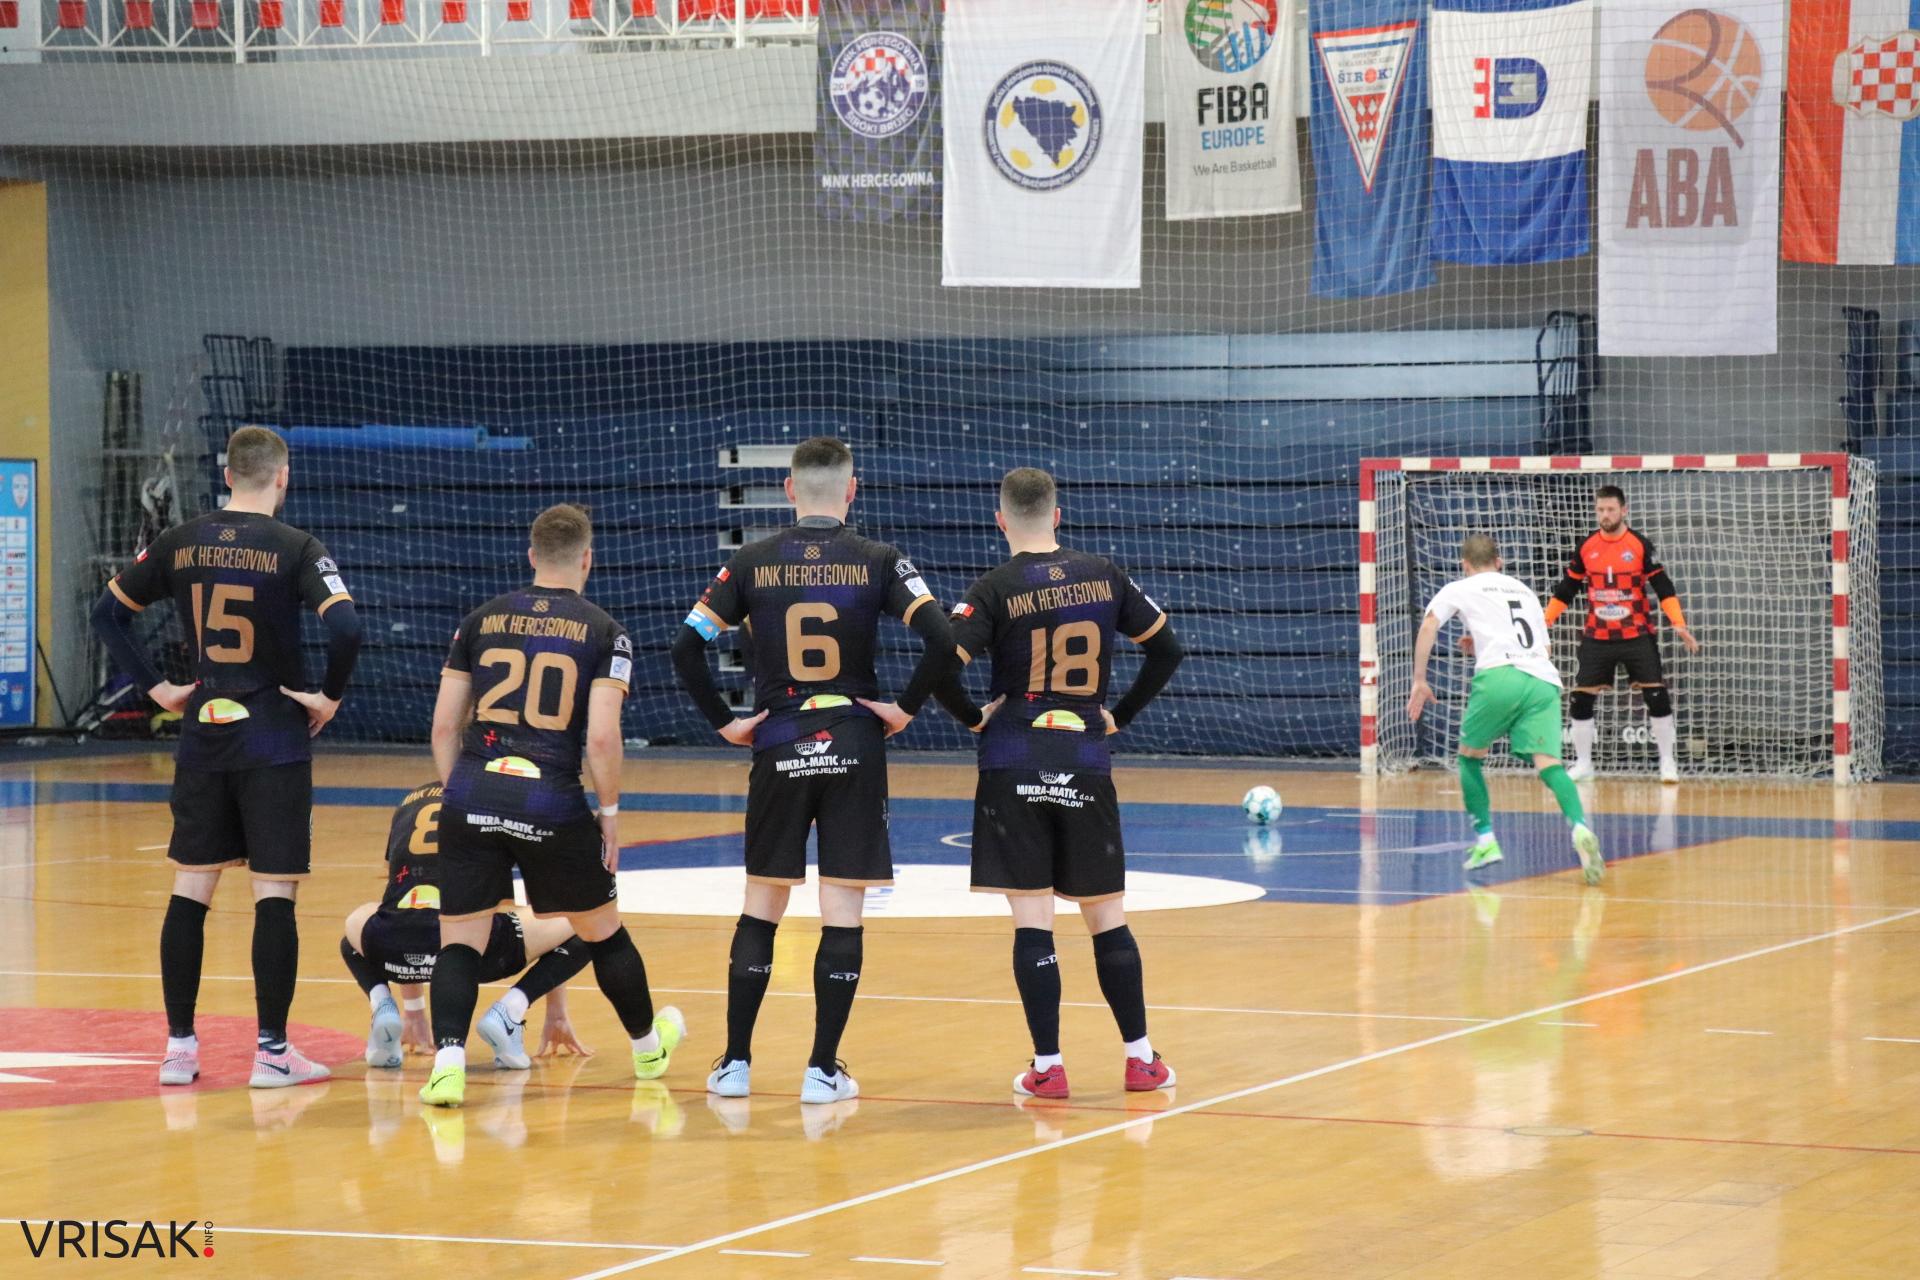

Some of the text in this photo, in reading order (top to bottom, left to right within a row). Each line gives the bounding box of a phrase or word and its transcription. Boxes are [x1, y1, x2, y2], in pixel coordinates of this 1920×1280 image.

[837, 36, 921, 73] MNK HERCEGOVINA
[1197, 82, 1269, 126] FIBA
[879, 106, 915, 134] BRIJEG
[1201, 126, 1265, 150] EUROPE
[822, 171, 934, 188] MNK HERCEGOVINA
[1193, 157, 1277, 176] We Are Basketball
[1626, 146, 1738, 228] ABA
[174, 545, 278, 574] MNK HERCEGOVINA
[754, 565, 782, 588] MNK
[784, 564, 869, 586] HERCEGOVINA
[1006, 580, 1113, 619] MNK HERCEGOVINA
[191, 583, 255, 663] 15
[480, 614, 588, 644] MNK HERCEGOVINA
[1507, 600, 1534, 649] 5
[785, 602, 841, 682] 6
[1028, 620, 1101, 697] 18
[476, 647, 578, 731] 20
[776, 755, 859, 772] MIKRA-MATIC d.o.o.
[789, 767, 848, 778] AUTODIJELOVI
[1016, 784, 1078, 799] MIKRA-MATIC
[1027, 795, 1084, 808] AUTODIJELOVI
[466, 813, 535, 834] MIKRA-MATIC
